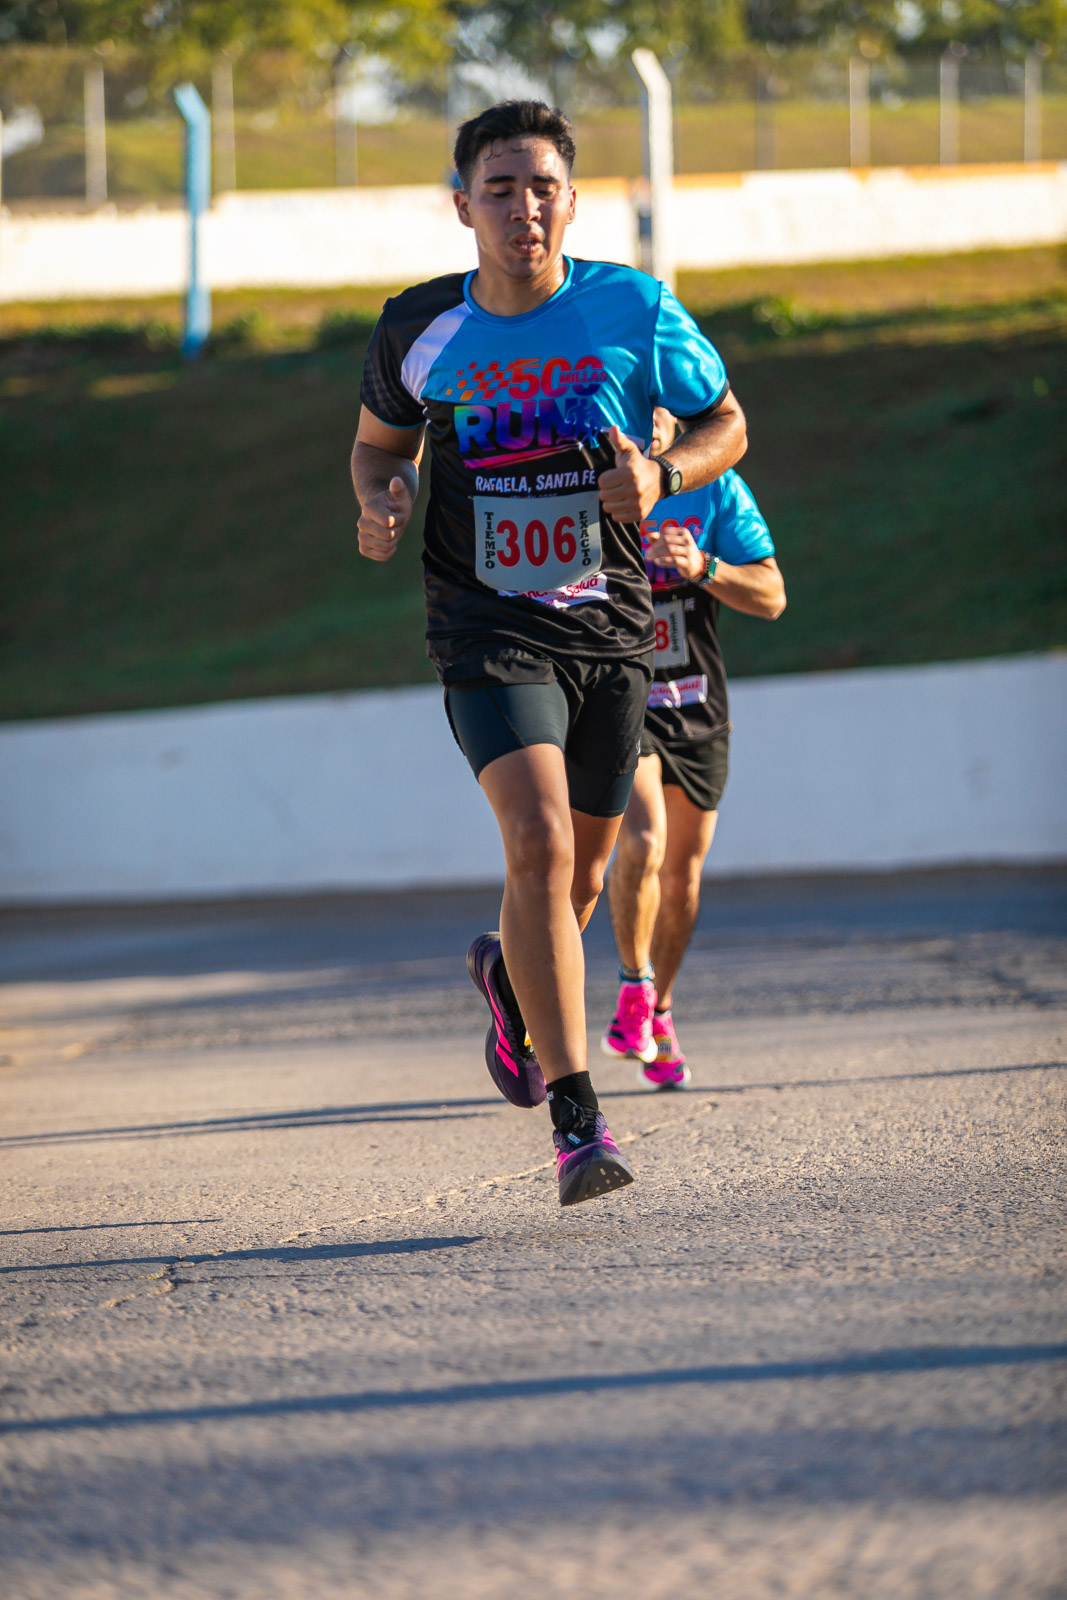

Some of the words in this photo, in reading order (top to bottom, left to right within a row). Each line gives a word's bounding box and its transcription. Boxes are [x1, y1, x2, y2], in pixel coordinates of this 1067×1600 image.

[508, 356, 604, 400] 500
[559, 371, 608, 384] MILLAS
[454, 398, 600, 453] RUN
[475, 475, 532, 493] RAFAELA,
[536, 471, 579, 491] SANTA
[582, 469, 596, 486] FE
[484, 511, 496, 570] TIEMPO
[496, 516, 577, 568] 306
[578, 510, 592, 566] EXACTO
